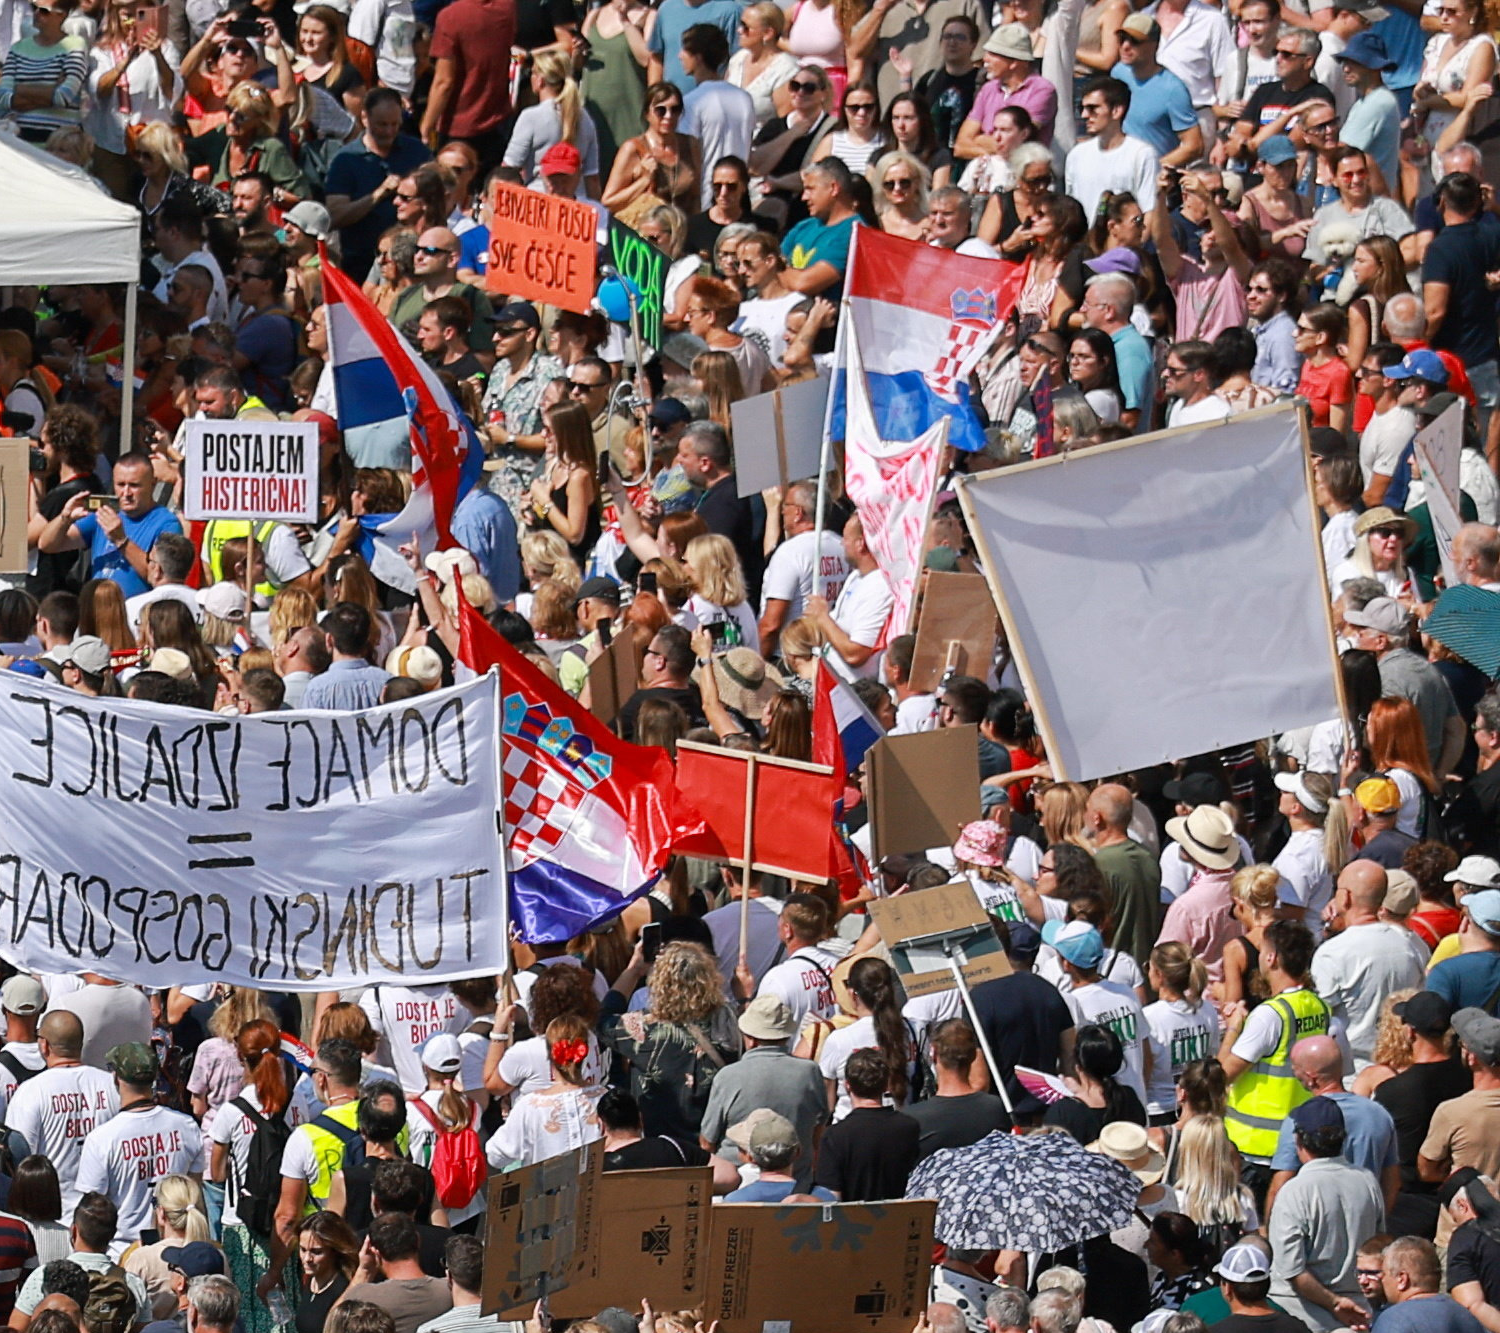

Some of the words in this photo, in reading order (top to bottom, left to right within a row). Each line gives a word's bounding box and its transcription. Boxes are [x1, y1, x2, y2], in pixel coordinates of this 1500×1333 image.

[556, 203, 598, 245] PUŠU
[491, 242, 518, 277] SVE
[524, 240, 576, 295] ČEŠĆE
[202, 432, 304, 474] POSTAJEM
[202, 473, 307, 514] HISTERIČNA!
[1293, 1013, 1330, 1038] REDAR
[50, 1093, 90, 1116] DOSTA
[120, 1134, 160, 1160] DOSTA
[719, 1226, 734, 1280] FREEZER
[719, 1282, 734, 1321] CHEST
